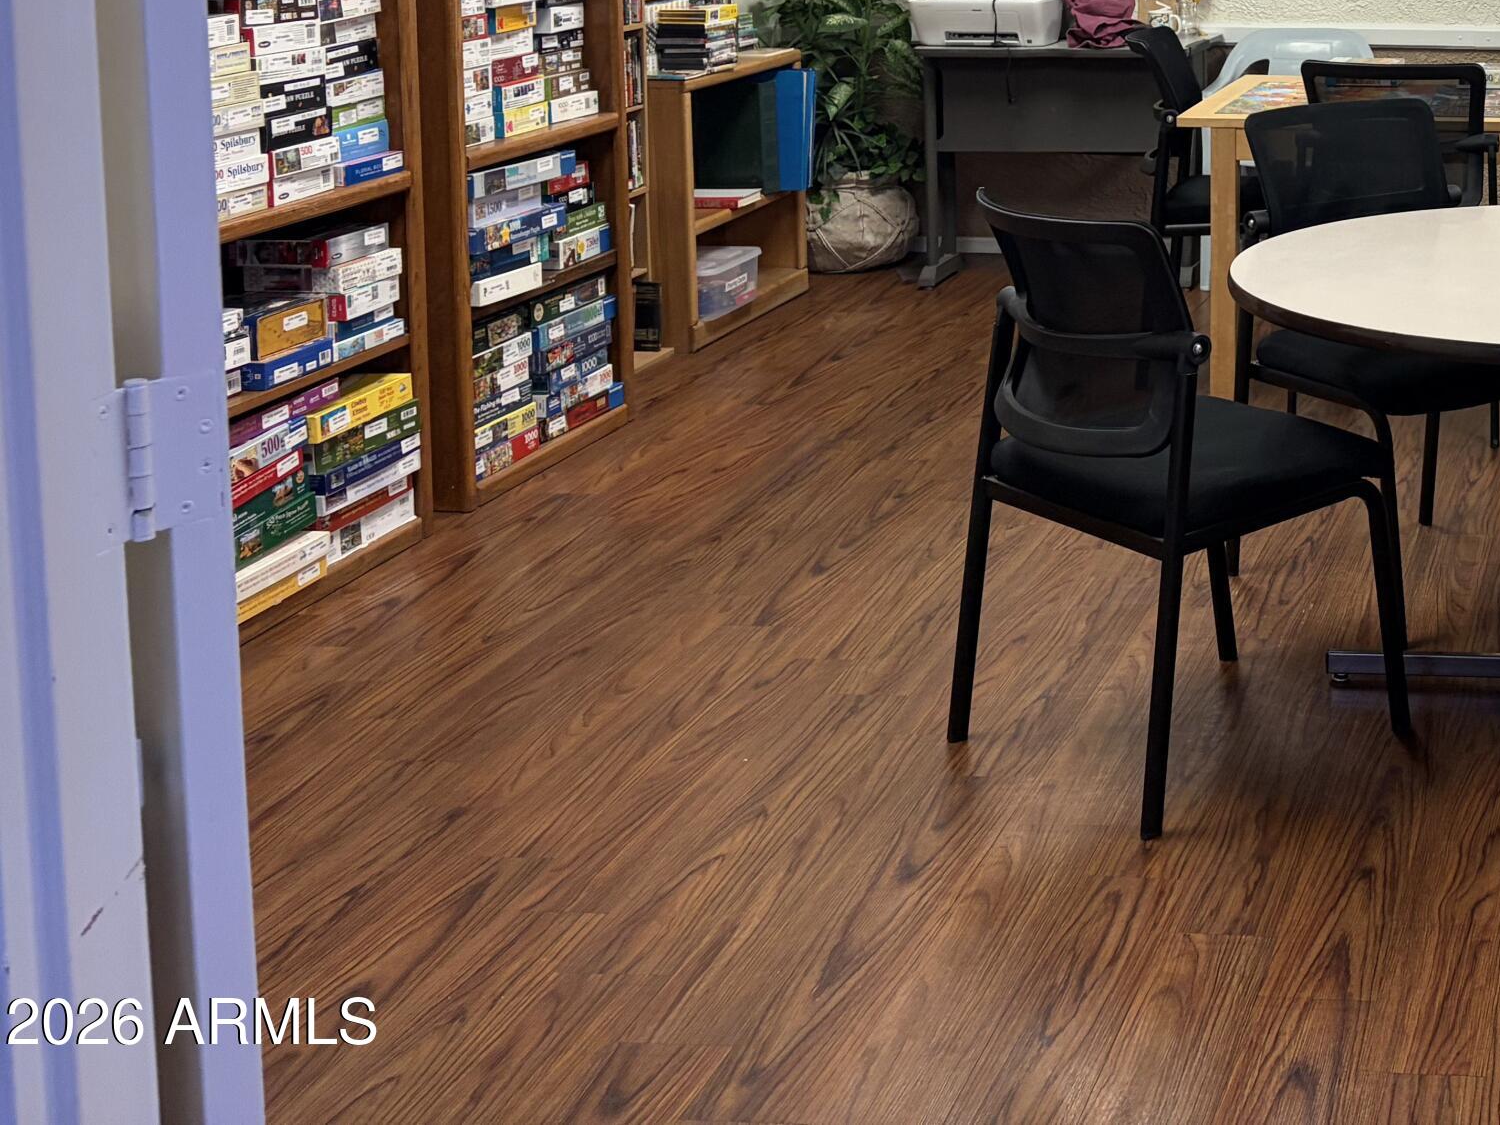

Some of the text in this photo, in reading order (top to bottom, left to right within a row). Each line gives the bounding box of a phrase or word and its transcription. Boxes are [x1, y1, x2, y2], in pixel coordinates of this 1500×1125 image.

[220, 134, 256, 152] Spilsbury
[301, 145, 313, 156] 500
[227, 161, 265, 179] Spilsbury
[517, 336, 530, 350] 1000
[514, 360, 528, 375] 1000
[582, 356, 598, 373] 1000
[522, 408, 536, 422] 1000
[525, 429, 539, 444] 1000
[261, 434, 280, 458] 500
